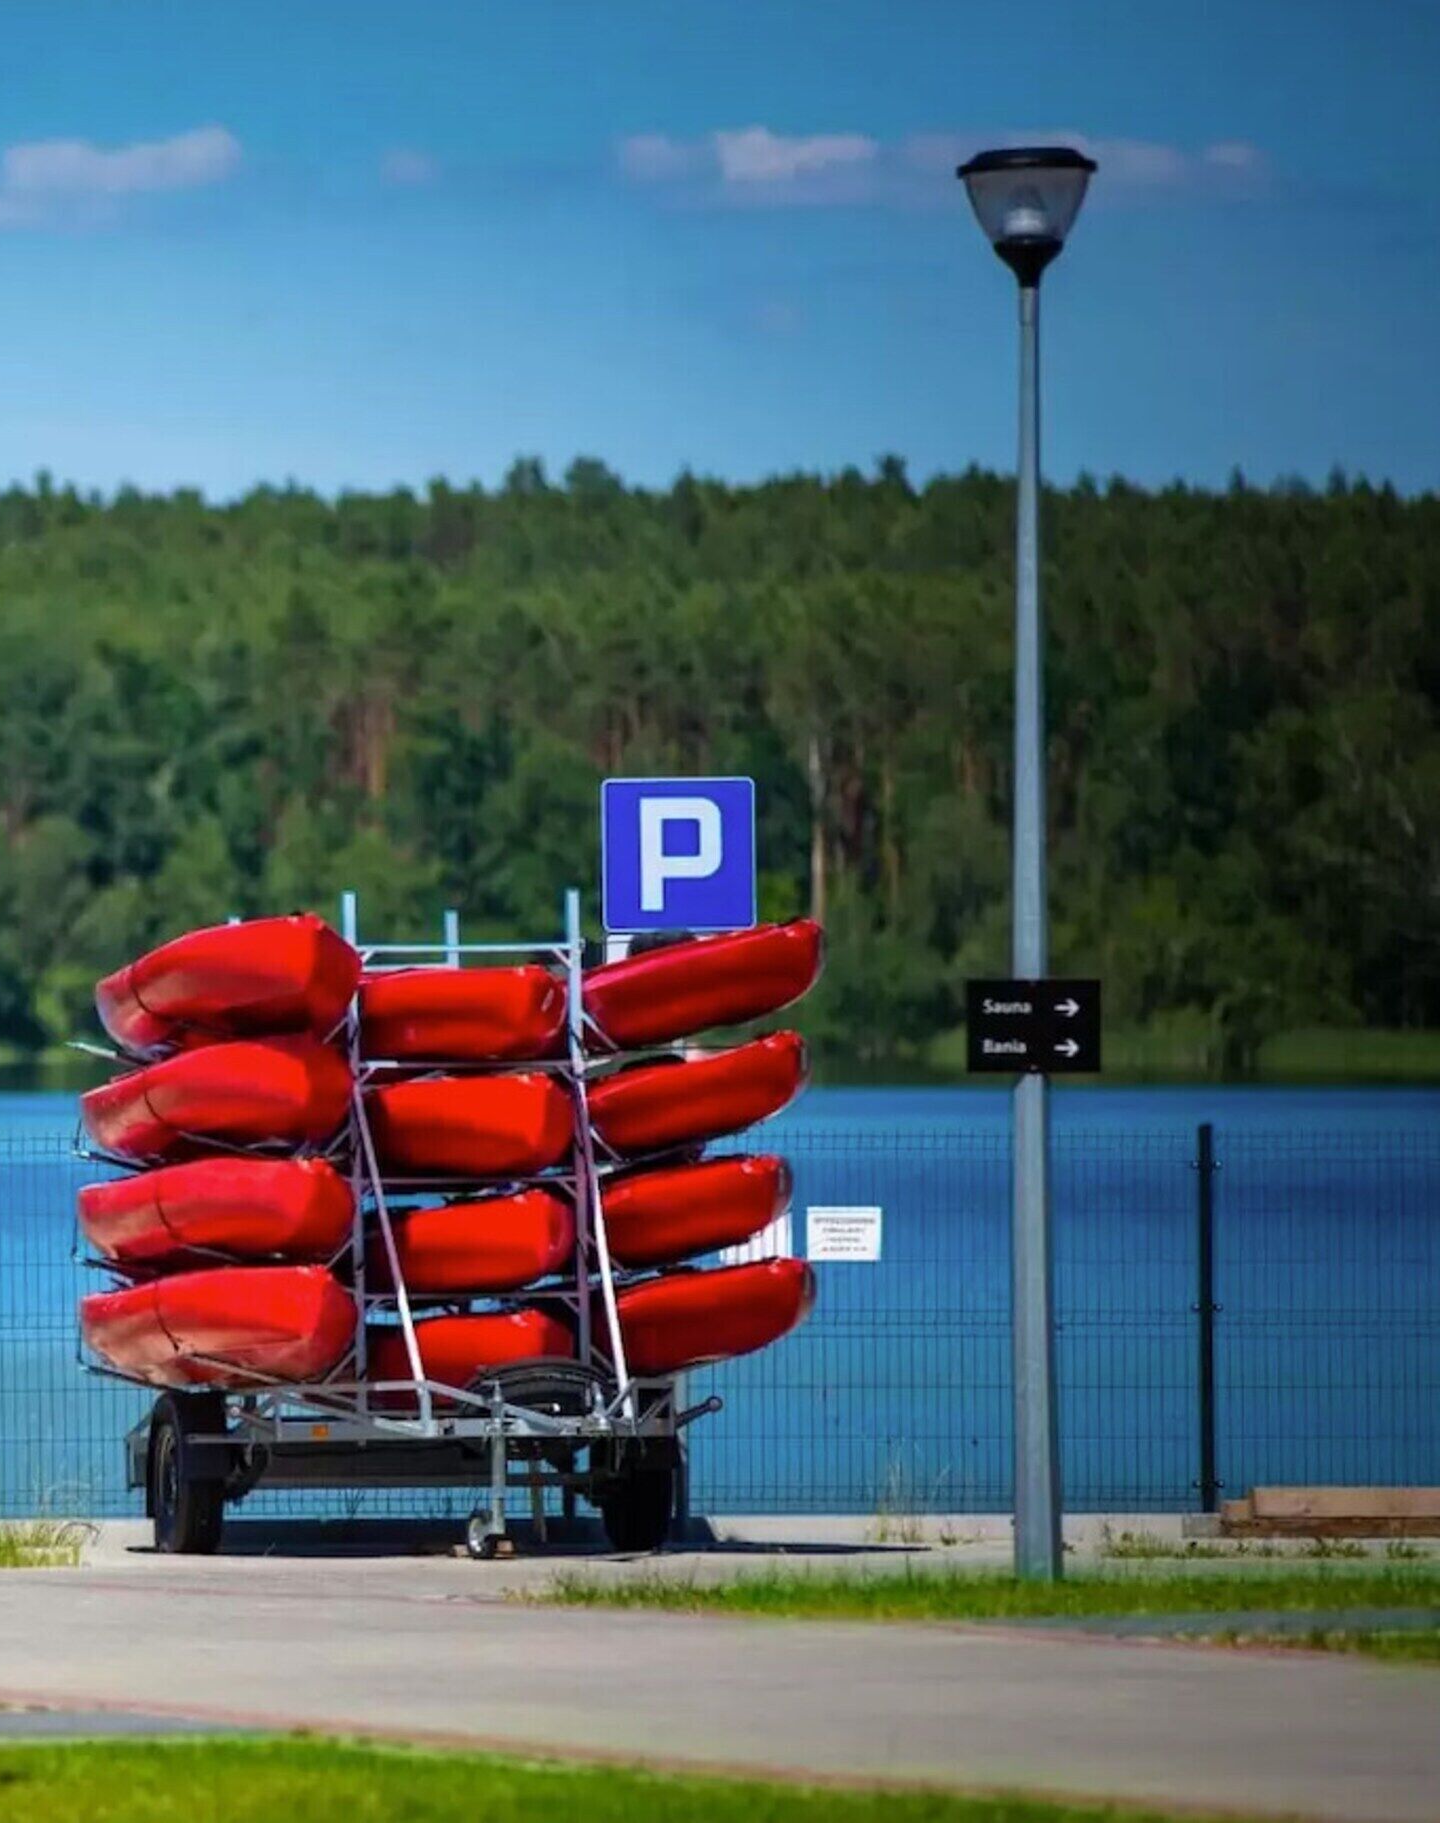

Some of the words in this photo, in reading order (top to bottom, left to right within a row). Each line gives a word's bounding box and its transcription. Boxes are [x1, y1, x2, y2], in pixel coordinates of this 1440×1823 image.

[639, 797, 722, 912] P
[982, 998, 1033, 1014] Sauna
[982, 1038, 1028, 1054] Bania
